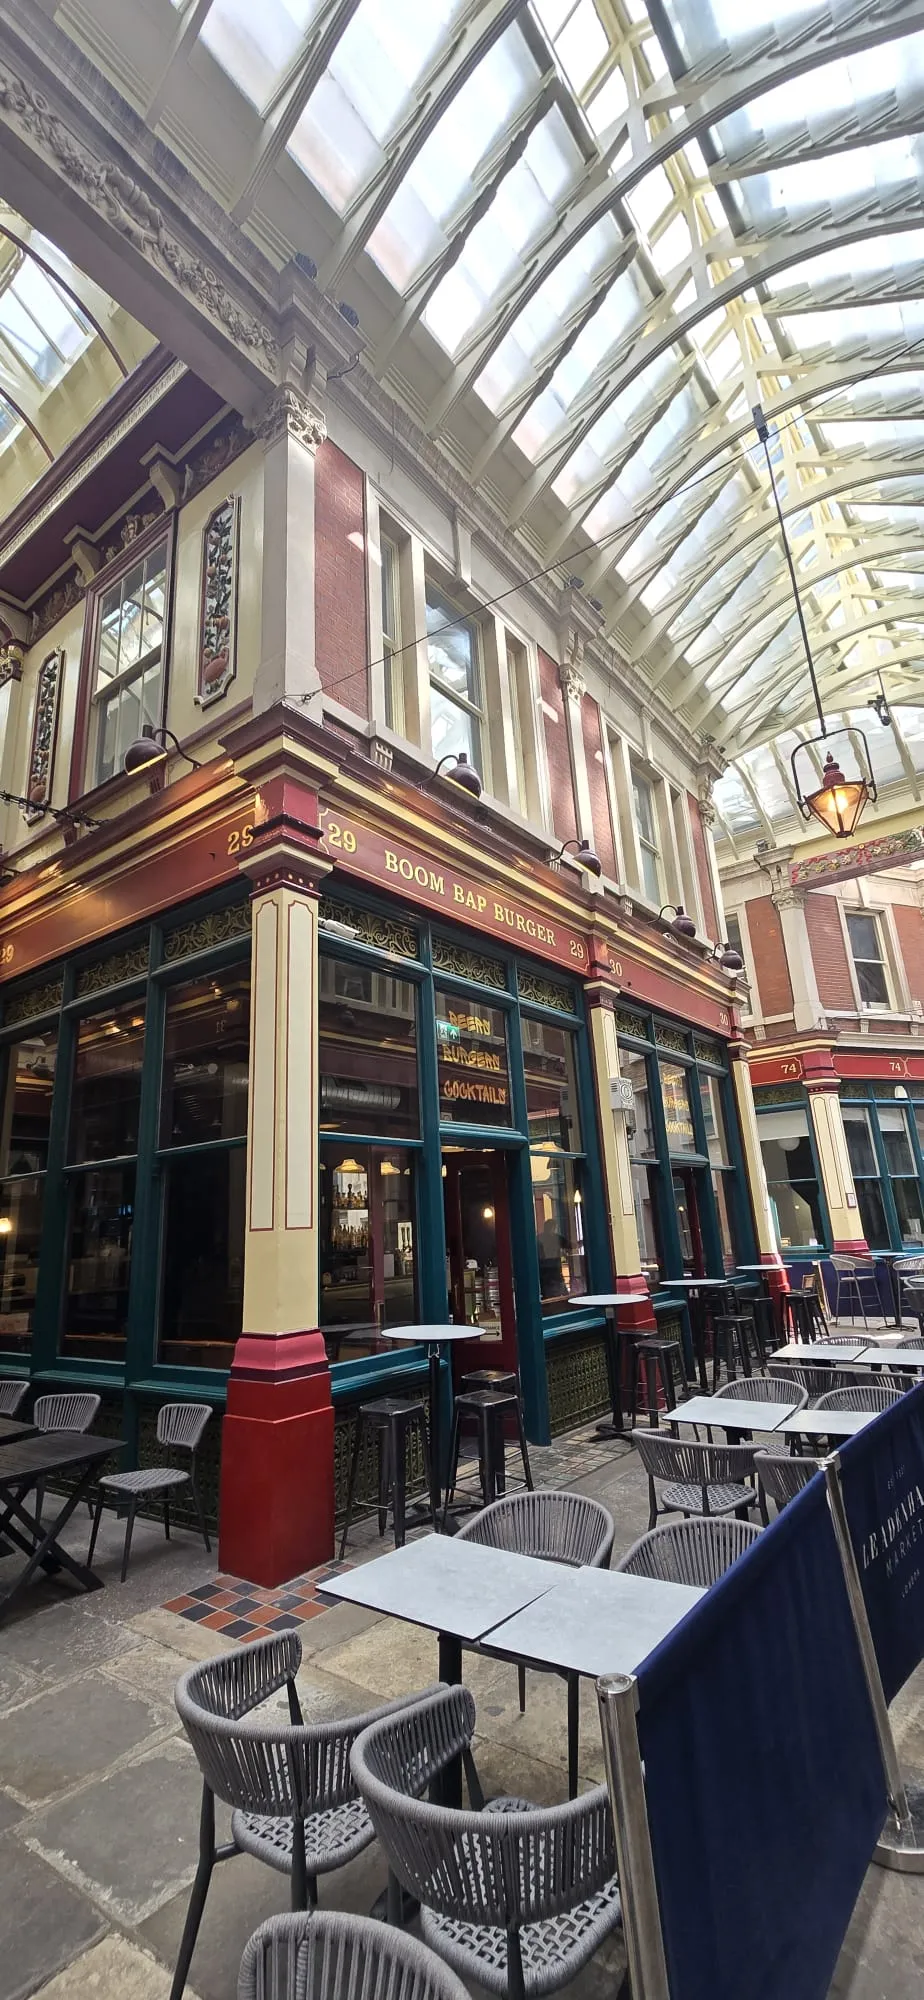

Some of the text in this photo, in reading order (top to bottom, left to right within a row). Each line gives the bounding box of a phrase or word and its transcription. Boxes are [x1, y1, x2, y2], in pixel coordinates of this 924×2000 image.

[227, 824, 254, 856] 29
[327, 822, 357, 853] 29
[384, 850, 557, 947] BOOM BAP BURGER
[570, 940, 585, 959] 29
[609, 959, 622, 977] 30
[448, 1010, 491, 1036] BEERS
[442, 1043, 500, 1071] BURGERS
[781, 1062, 797, 1074] 74
[889, 1062, 901, 1072] 74
[443, 1079, 507, 1105] COCKTAILS
[885, 1518, 923, 1579] MARKET
